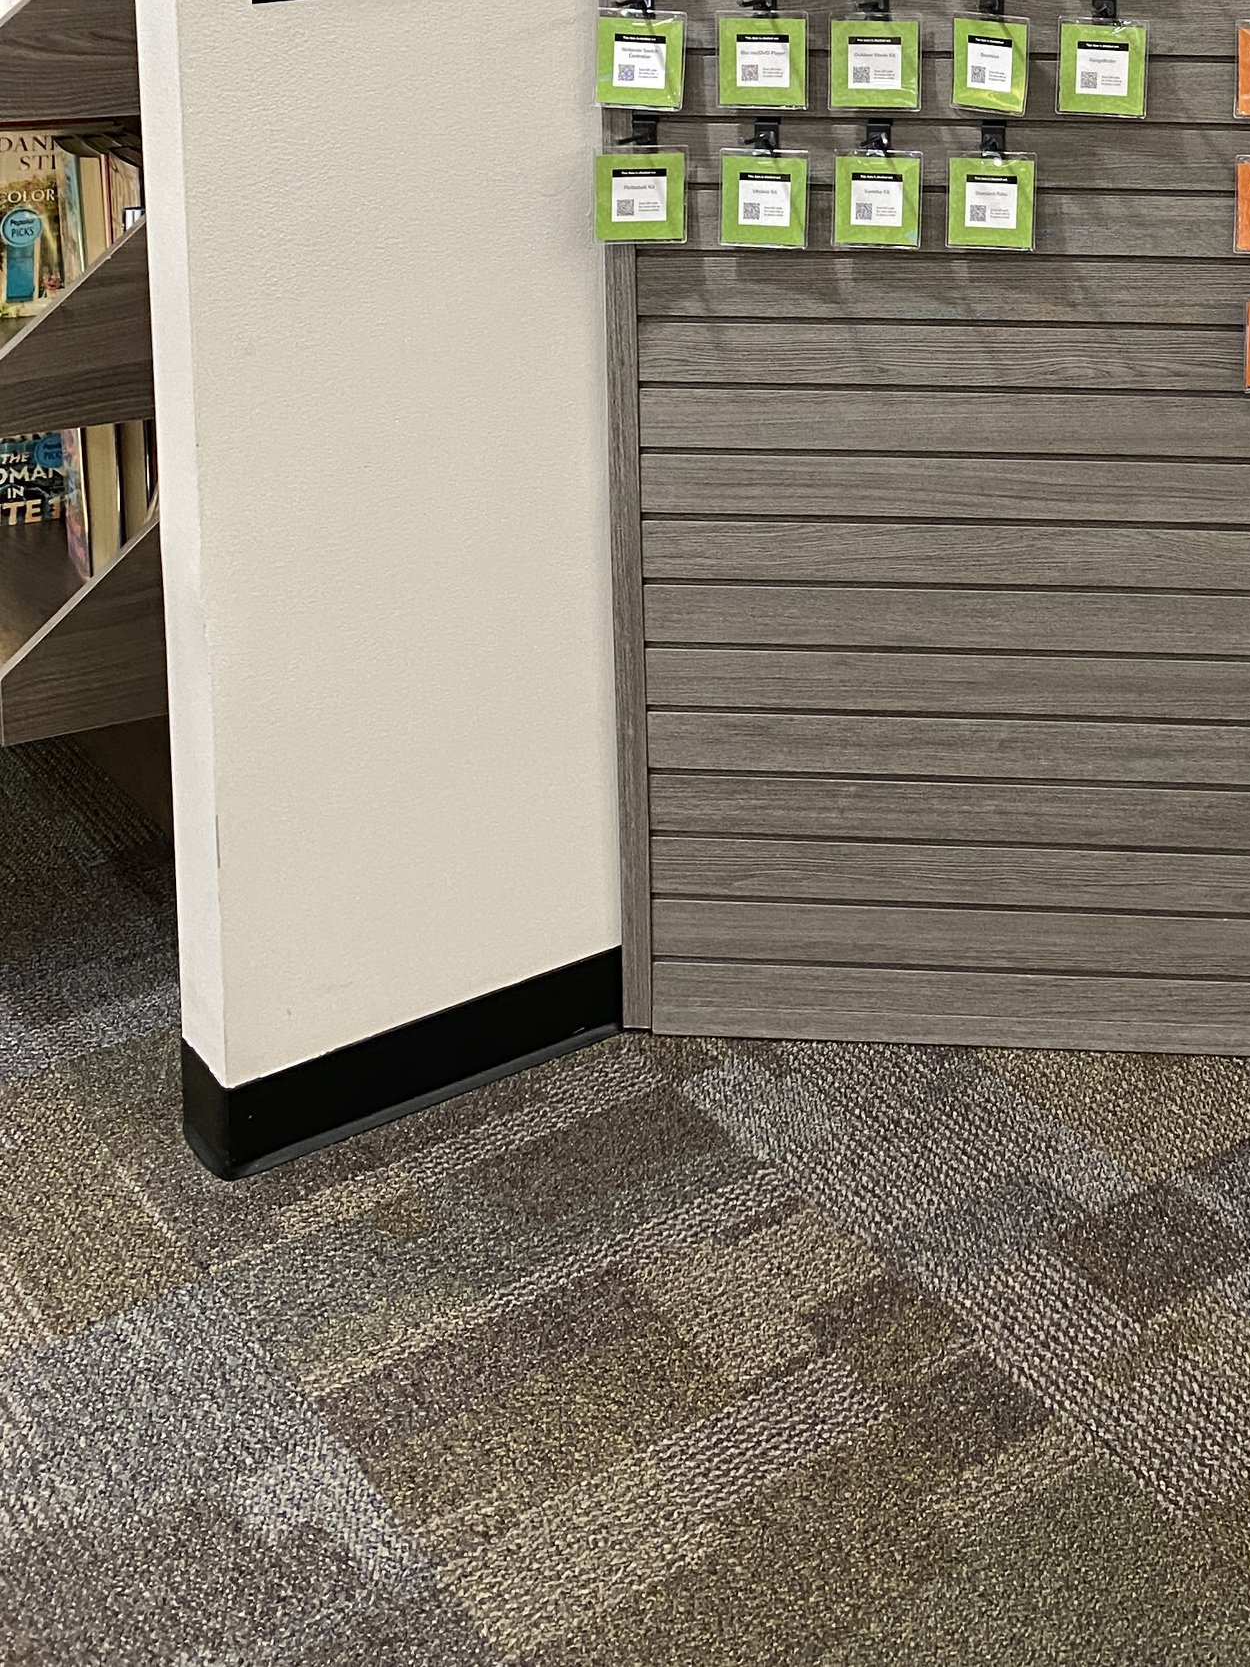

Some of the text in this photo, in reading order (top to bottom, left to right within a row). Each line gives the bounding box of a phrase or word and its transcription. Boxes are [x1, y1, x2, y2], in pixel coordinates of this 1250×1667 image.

[11, 227, 34, 237] PICKS
[1, 452, 30, 464] THE
[7, 486, 24, 499] IN
